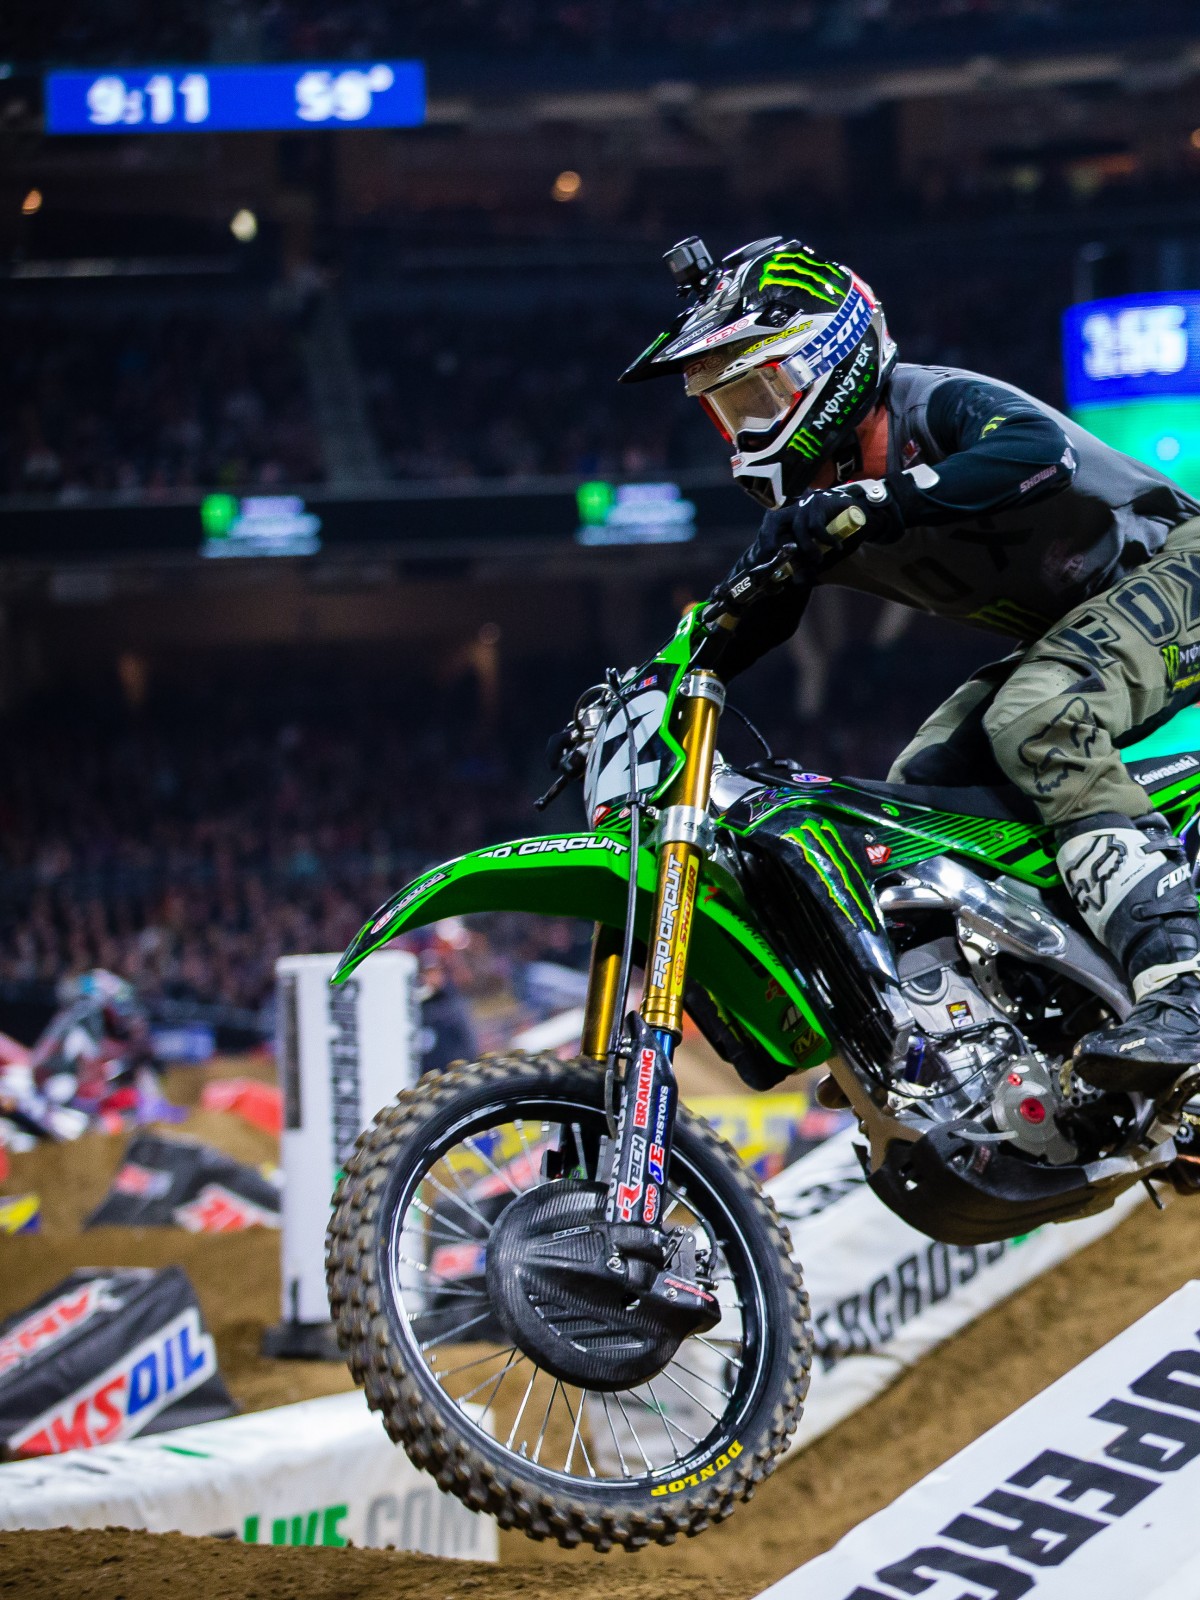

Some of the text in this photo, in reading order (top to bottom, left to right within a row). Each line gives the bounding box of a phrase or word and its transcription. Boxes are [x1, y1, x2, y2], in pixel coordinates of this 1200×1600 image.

[736, 320, 813, 356] RO CIRCUIT
[812, 343, 873, 430] MONSTER
[836, 363, 875, 425] ENERGY
[1019, 465, 1057, 493] SHOWA
[518, 836, 628, 857] CIRCUIT
[680, 865, 697, 946] SHOWA
[1156, 863, 1192, 897] FOX
[652, 854, 683, 989] PRO CIRCUIT
[633, 1048, 656, 1129] BRAKING
[649, 1086, 669, 1185] JE PISTONS
[651, 1440, 744, 1496] DUNLOP
